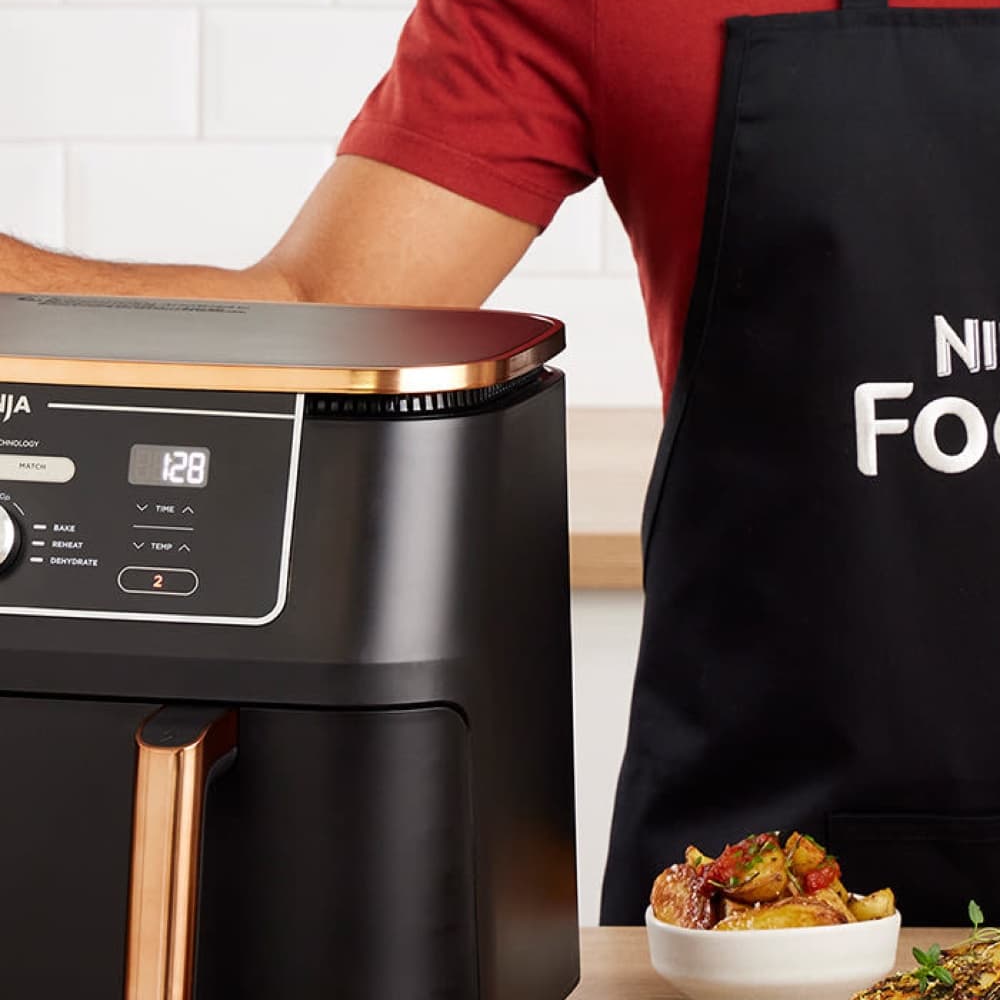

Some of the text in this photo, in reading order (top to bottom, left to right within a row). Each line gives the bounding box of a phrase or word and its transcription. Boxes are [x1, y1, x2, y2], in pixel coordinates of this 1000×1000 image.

[19, 462, 47, 471] MATCH
[155, 505, 175, 513] TIME
[53, 524, 76, 532] BAKE
[52, 540, 83, 549] REHEAT
[151, 542, 173, 551] TEMP
[50, 556, 98, 567] DEHYDRATE
[152, 574, 164, 588] 2
